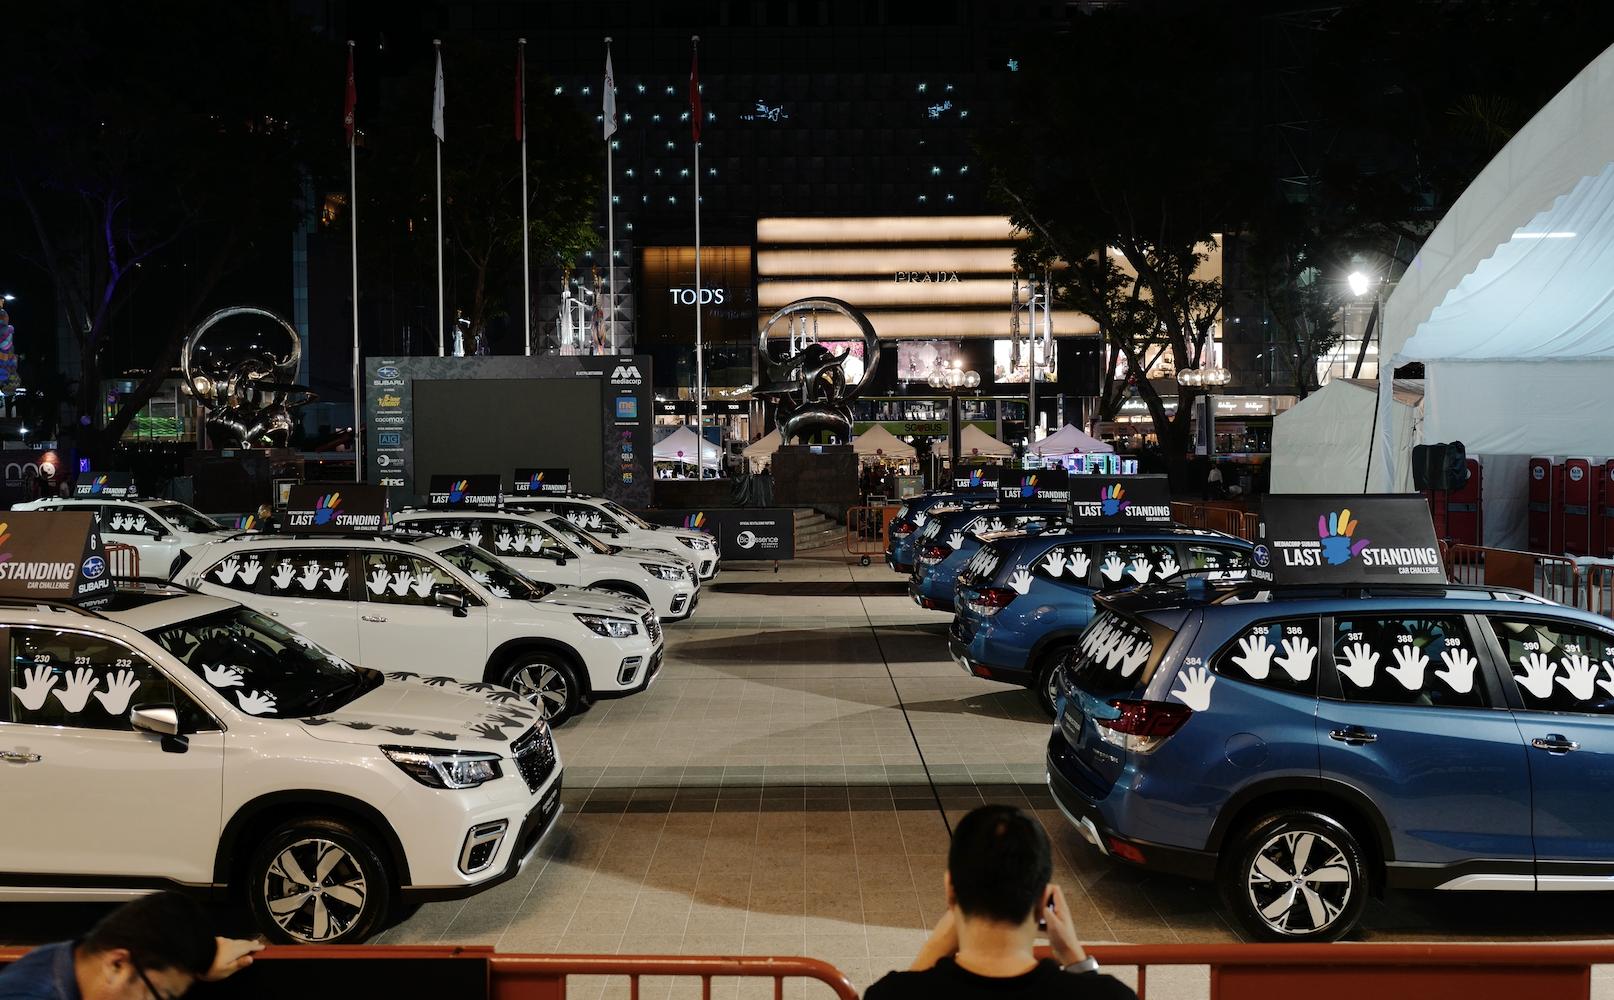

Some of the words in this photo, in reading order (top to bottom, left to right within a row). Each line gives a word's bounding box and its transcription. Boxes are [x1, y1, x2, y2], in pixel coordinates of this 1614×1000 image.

[894, 271, 961, 283] PRADA
[669, 288, 724, 305] TOD'S
[611, 378, 642, 386] mediacorp
[381, 435, 398, 443] AIG
[1005, 490, 1021, 498] LAST
[1079, 506, 1102, 517] LAST
[1125, 506, 1170, 517] STANDING
[290, 515, 315, 526] LAST
[336, 515, 380, 526] STANDING
[1259, 522, 1265, 538] 10
[90, 534, 97, 550] 6
[1283, 548, 1322, 566] LAST
[1361, 547, 1438, 566] STANDING
[0, 562, 75, 580] STANDING
[1250, 568, 1274, 582] SUBARU
[27, 581, 39, 589] CAR
[39, 581, 71, 590] CHALLENGE
[78, 579, 110, 594] SUBARU
[1253, 627, 1269, 635] 385
[1286, 627, 1303, 635] 386
[1347, 632, 1363, 641] 387
[1396, 634, 1413, 643] 388
[1444, 638, 1461, 646] 389
[1522, 642, 1540, 650] 390
[1564, 644, 1581, 653] 391
[34, 655, 51, 663] 230
[74, 656, 91, 665] 231
[115, 659, 132, 668] 232
[1185, 657, 1201, 665] 384
